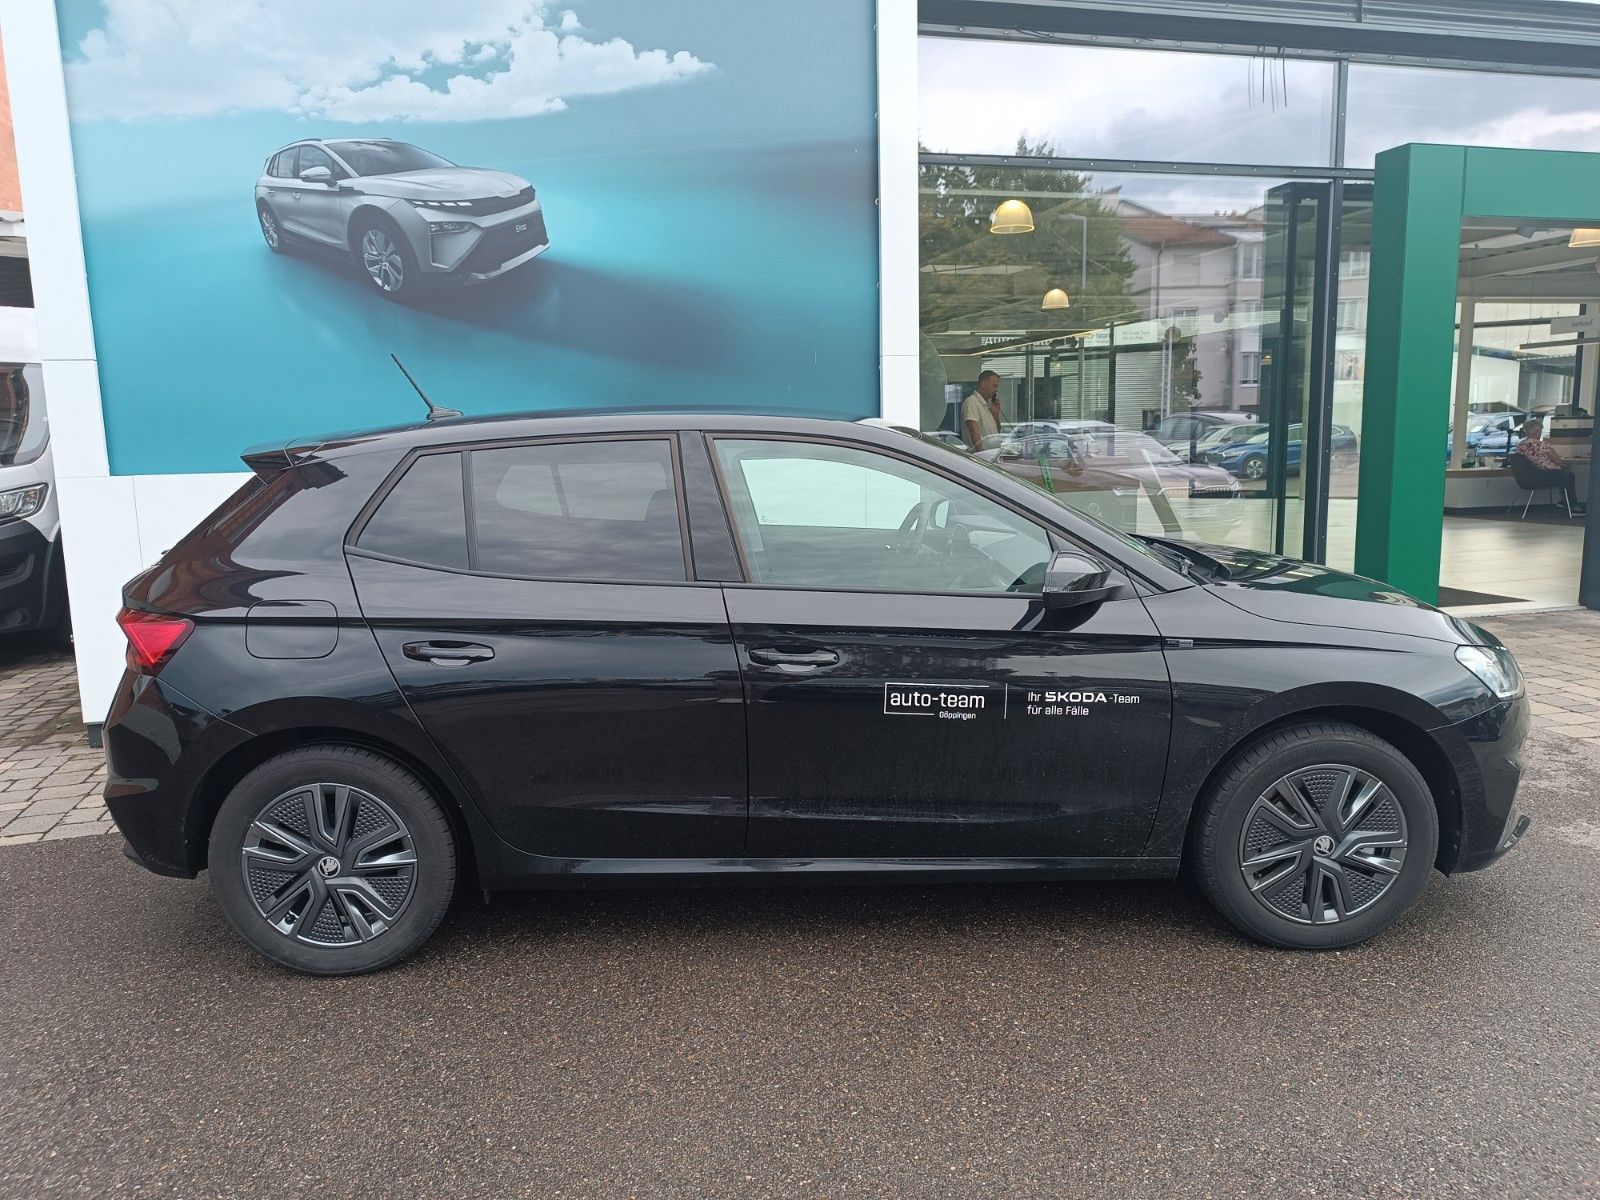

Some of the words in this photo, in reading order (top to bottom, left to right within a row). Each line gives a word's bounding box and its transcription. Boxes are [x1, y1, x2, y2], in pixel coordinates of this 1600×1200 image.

[890, 691, 985, 709] auto-team
[1027, 691, 1041, 702] Ihr
[939, 710, 977, 720] Göppingen
[1026, 704, 1042, 715] für
[1045, 705, 1063, 715] alle
[1065, 705, 1089, 716] Fälle
